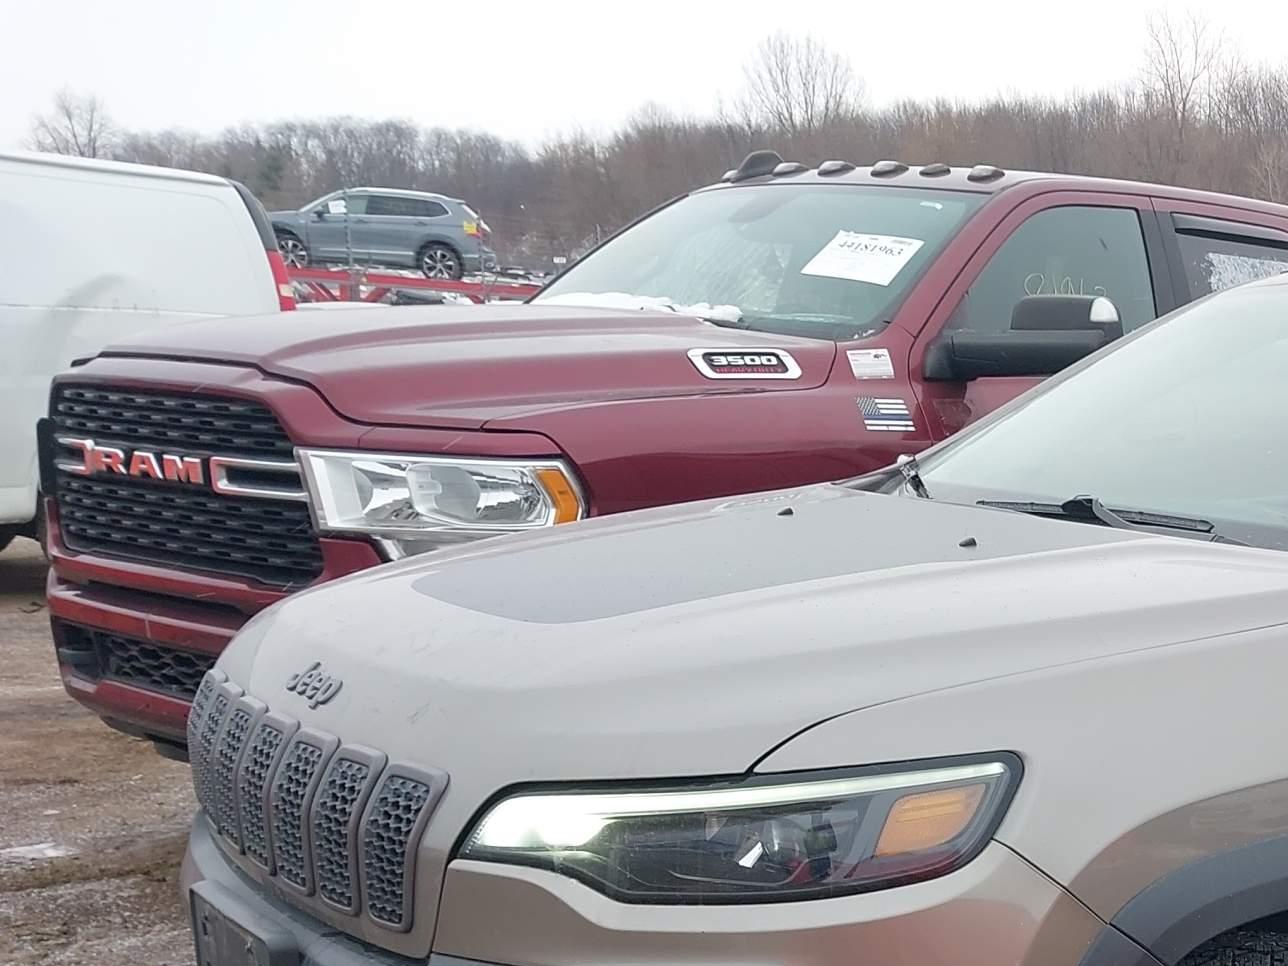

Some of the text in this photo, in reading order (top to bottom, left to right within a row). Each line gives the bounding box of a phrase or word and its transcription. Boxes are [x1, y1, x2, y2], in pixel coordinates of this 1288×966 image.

[709, 355, 779, 366] 3500
[92, 446, 204, 485] RAM
[286, 661, 344, 711] Jeep
